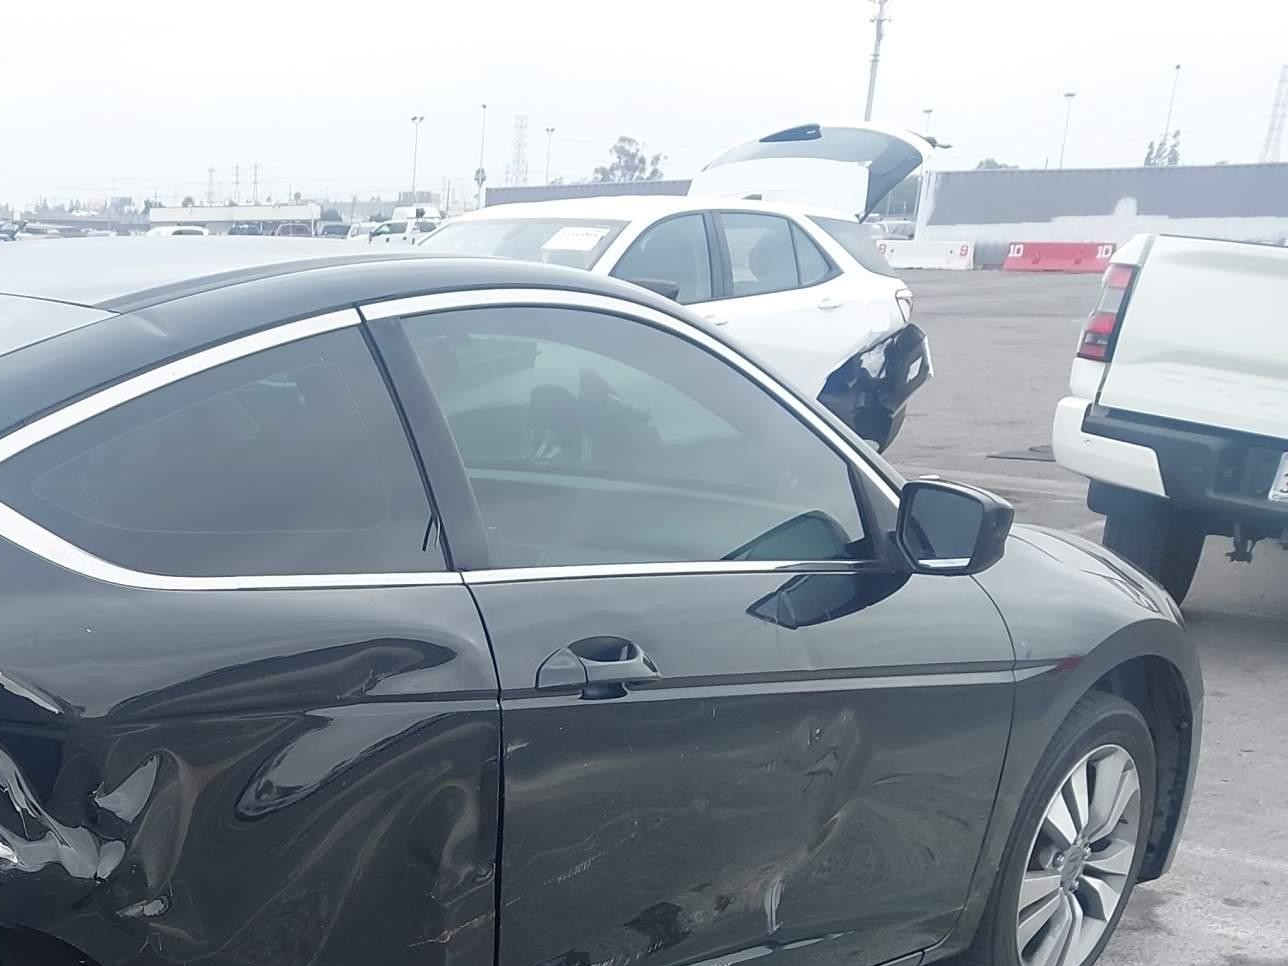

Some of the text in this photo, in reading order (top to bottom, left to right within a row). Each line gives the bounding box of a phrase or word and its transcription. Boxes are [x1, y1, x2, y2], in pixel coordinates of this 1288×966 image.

[959, 244, 969, 257] 9
[1008, 243, 1025, 258] 10
[1096, 244, 1113, 258] 10
